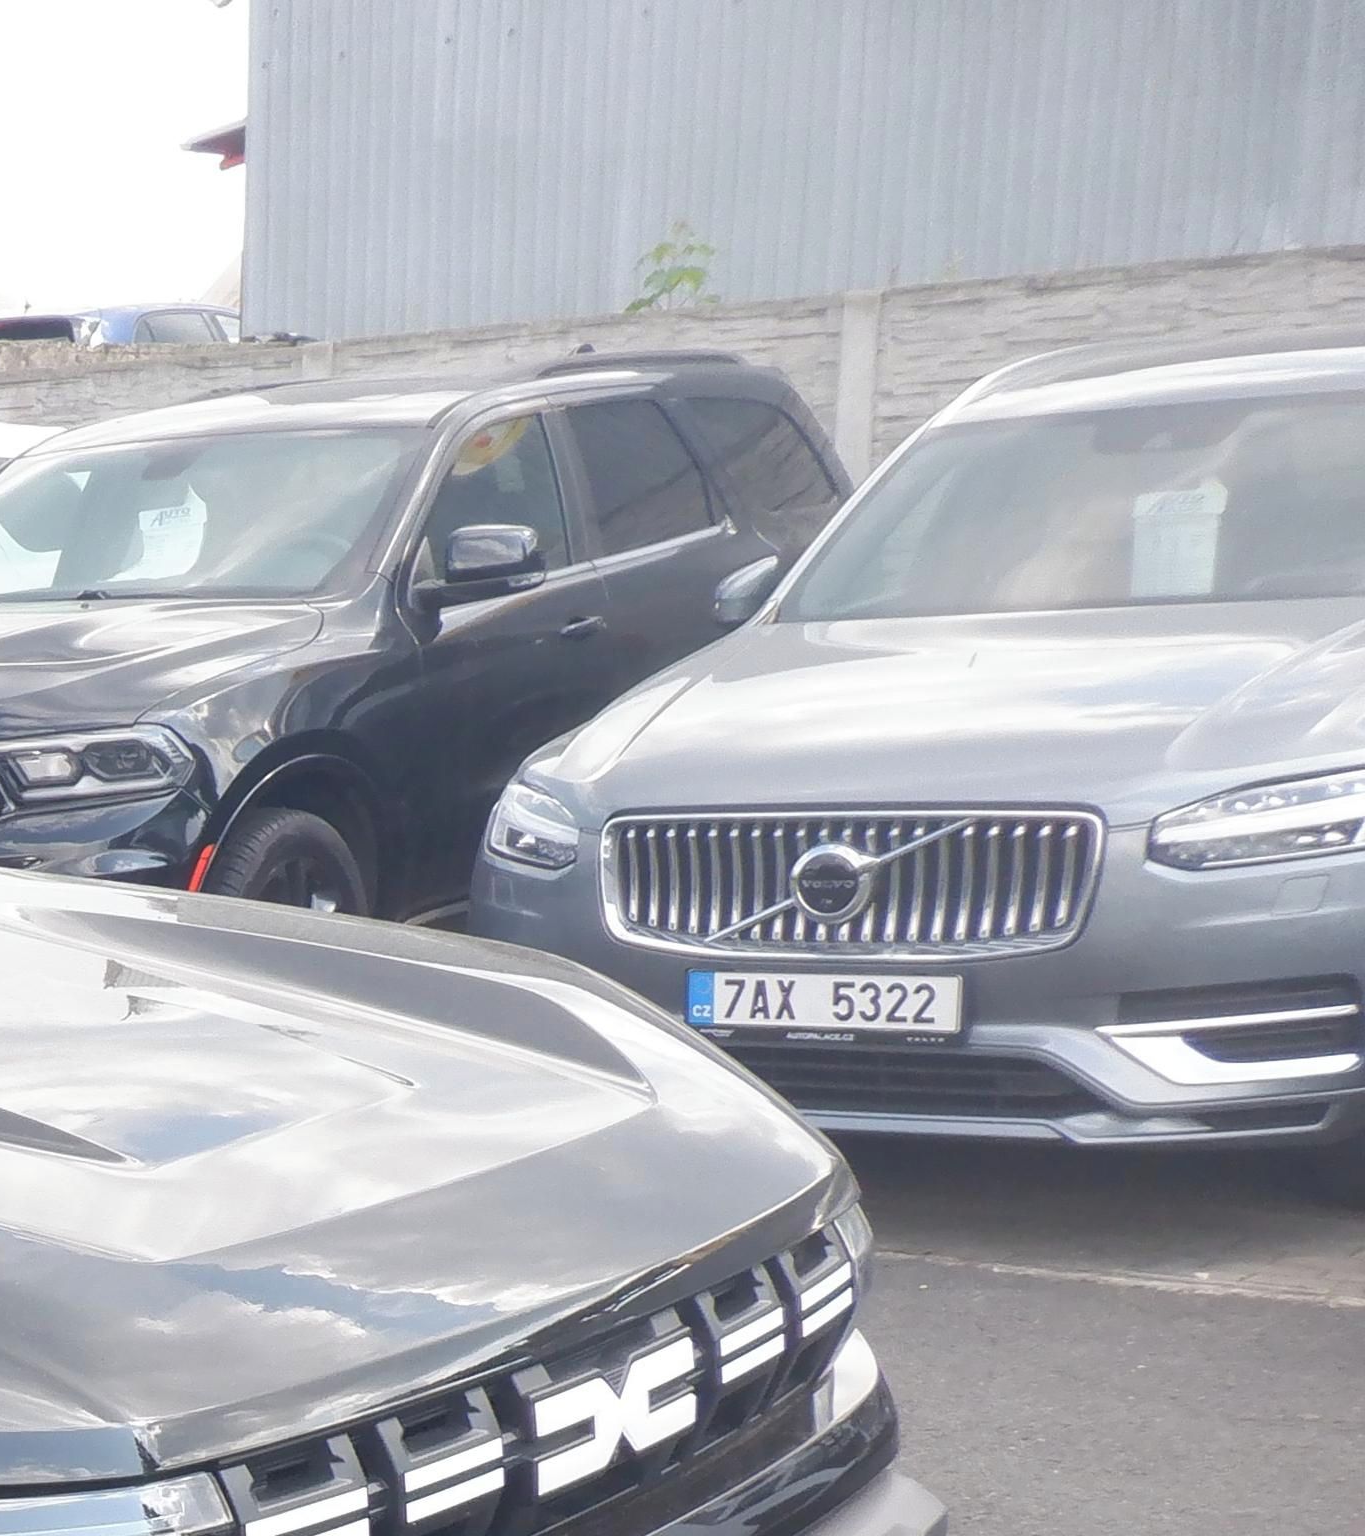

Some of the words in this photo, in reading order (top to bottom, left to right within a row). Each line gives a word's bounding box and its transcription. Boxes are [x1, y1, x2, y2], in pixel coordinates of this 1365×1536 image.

[801, 879, 856, 889] VOLVO
[723, 979, 796, 1020] 7AX
[832, 980, 936, 1024] 5322
[692, 1005, 712, 1017] CZ
